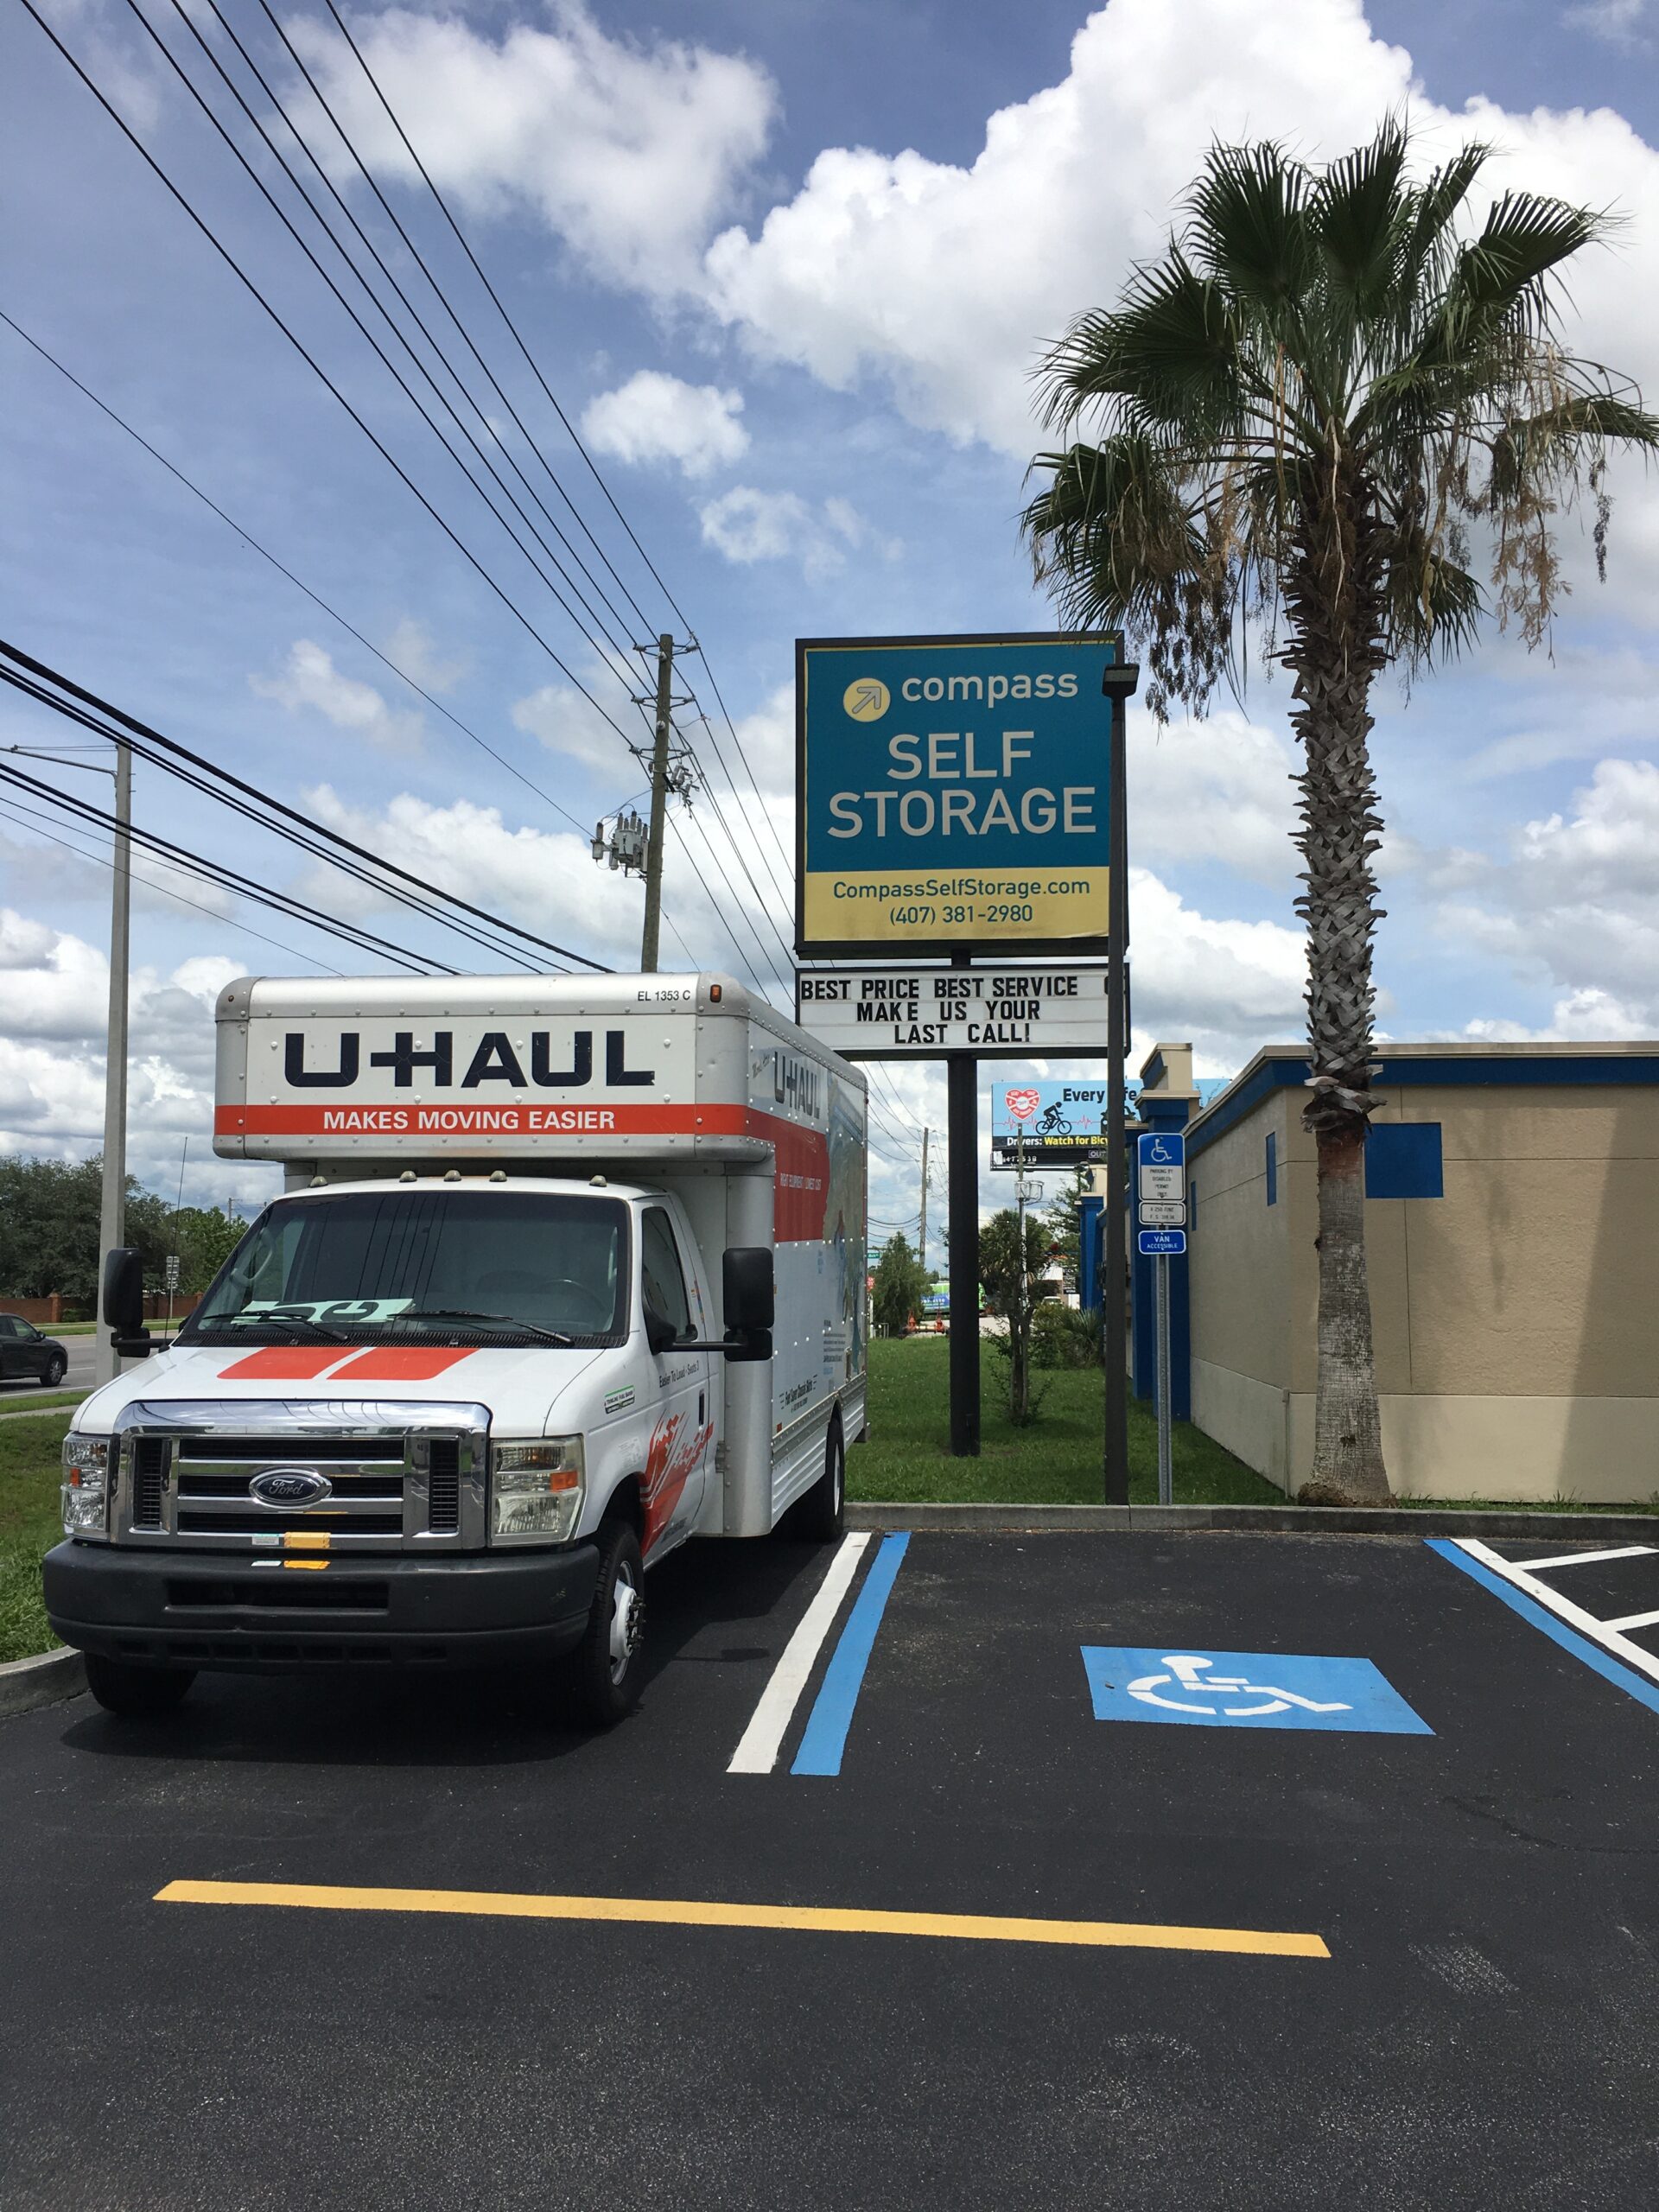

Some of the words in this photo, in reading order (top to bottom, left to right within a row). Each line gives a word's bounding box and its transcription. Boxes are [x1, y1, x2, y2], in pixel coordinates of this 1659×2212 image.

[901, 672, 1078, 709] compass
[887, 731, 1034, 779] SELF
[827, 786, 1096, 838] STORAGE
[833, 878, 1090, 902] CompassSelfStorage.com
[889, 906, 936, 925] (407)
[942, 904, 1033, 923] 381-2980
[637, 991, 652, 1001] EL
[655, 990, 679, 1001] 1353
[683, 989, 691, 1001] C
[801, 980, 851, 1000] BEST
[861, 979, 919, 999] PRICE
[934, 978, 984, 998] BEST
[992, 976, 1077, 997] SERVICE
[856, 1002, 918, 1022] MAKE
[940, 1001, 967, 1021] US
[986, 1000, 1040, 1020] YOUR
[894, 1024, 948, 1044] LAST
[968, 1023, 1031, 1043] CALL!
[283, 1029, 656, 1089] U-HAUL
[1063, 1088, 1106, 1103] Every
[323, 1111, 409, 1130] MAKES
[418, 1111, 519, 1130] MOVING
[528, 1110, 615, 1129] EASIER
[1007, 1136, 1043, 1147] Drvers:
[1044, 1136, 1074, 1147] Watch
[1075, 1136, 1089, 1146] for
[269, 1478, 303, 1495] Ford
